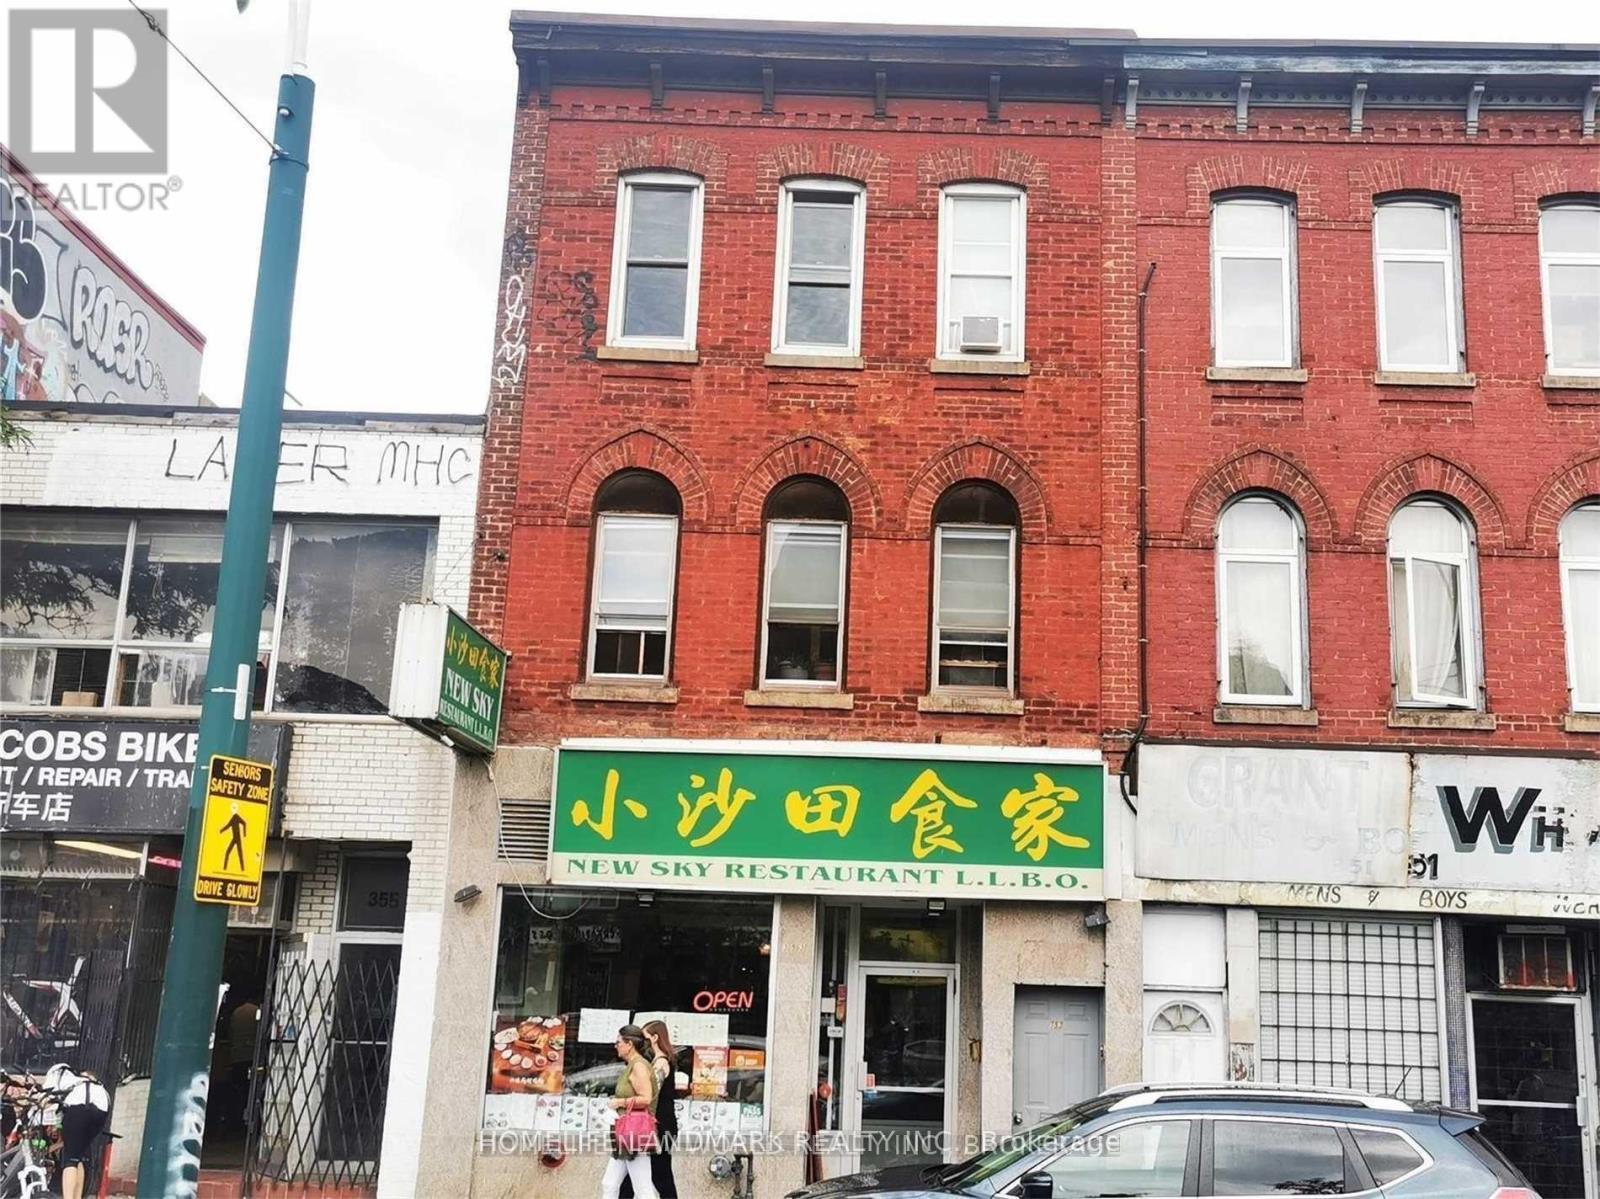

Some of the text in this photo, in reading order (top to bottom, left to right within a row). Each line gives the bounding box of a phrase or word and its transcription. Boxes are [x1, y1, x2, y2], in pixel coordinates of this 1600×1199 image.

[165, 435, 349, 486] LAER
[444, 667, 495, 722] NEW SKY
[0, 765, 18, 785] T
[38, 767, 122, 788] REPAIR
[143, 769, 194, 789] TRA
[222, 761, 262, 782] SENIORS
[210, 778, 269, 801] SAFETY ZONE
[570, 767, 1091, 860] 小沙田食家
[567, 859, 1089, 889] NEW SKY RESTAURANT L.L.B.O.
[197, 880, 223, 896] DRIVE
[1418, 889, 1468, 909] BOYS
[693, 990, 754, 1012] OPEN
